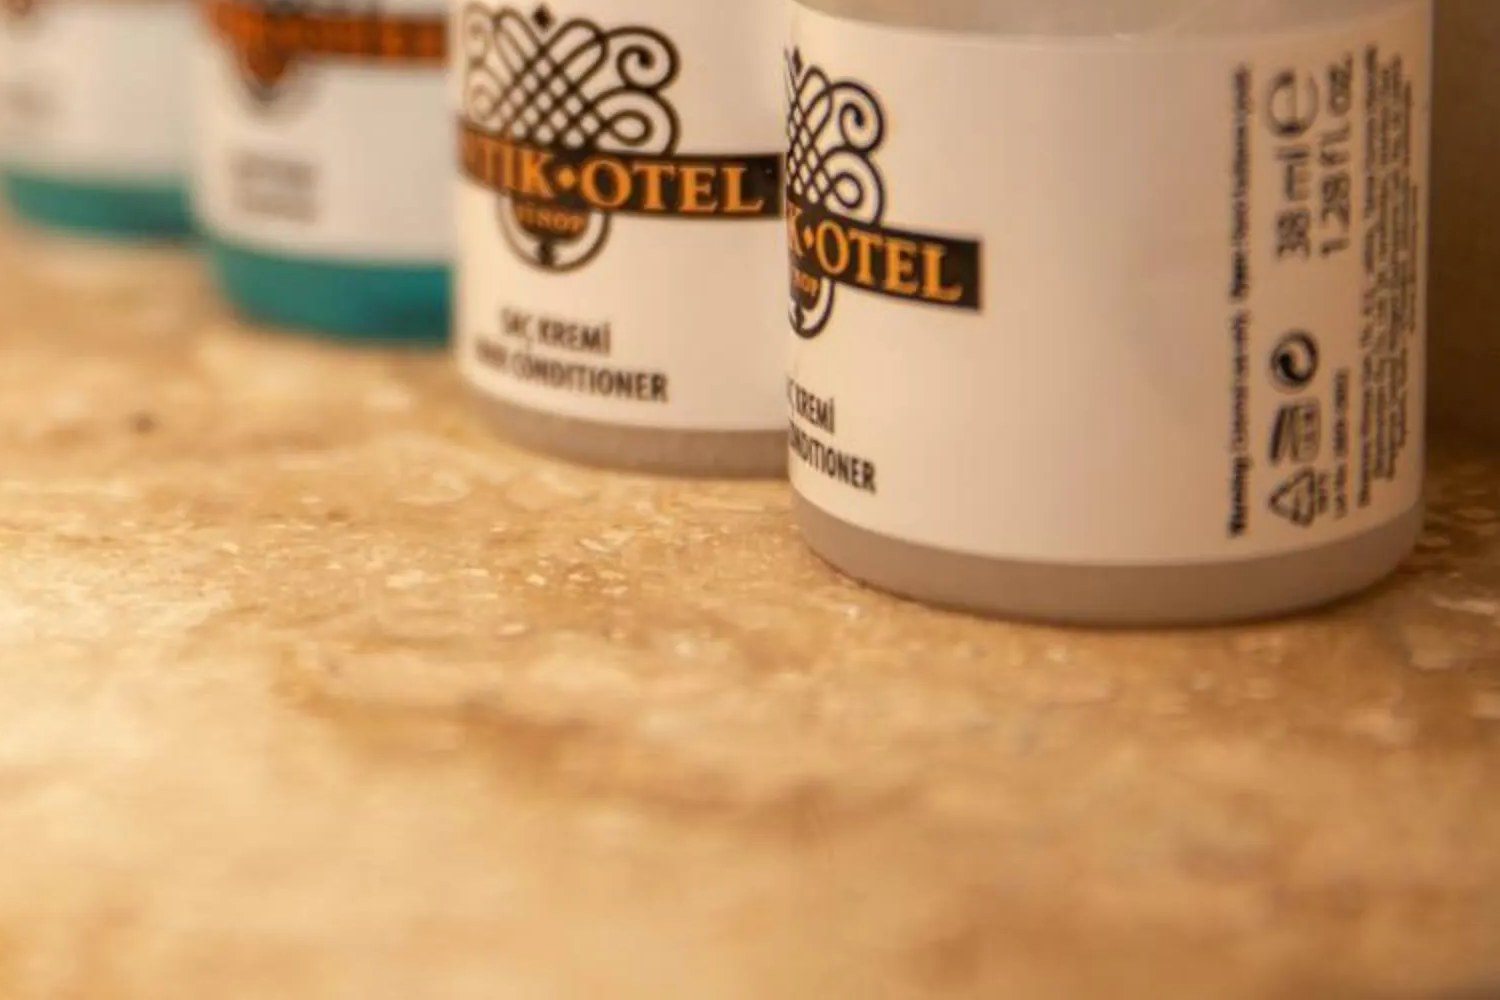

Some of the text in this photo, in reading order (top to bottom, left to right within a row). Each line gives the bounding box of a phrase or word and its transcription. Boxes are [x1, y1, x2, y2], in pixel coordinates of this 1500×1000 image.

[1274, 145, 1312, 203] ml
[1272, 208, 1312, 260] 38
[511, 352, 670, 404] CONDITIONER
